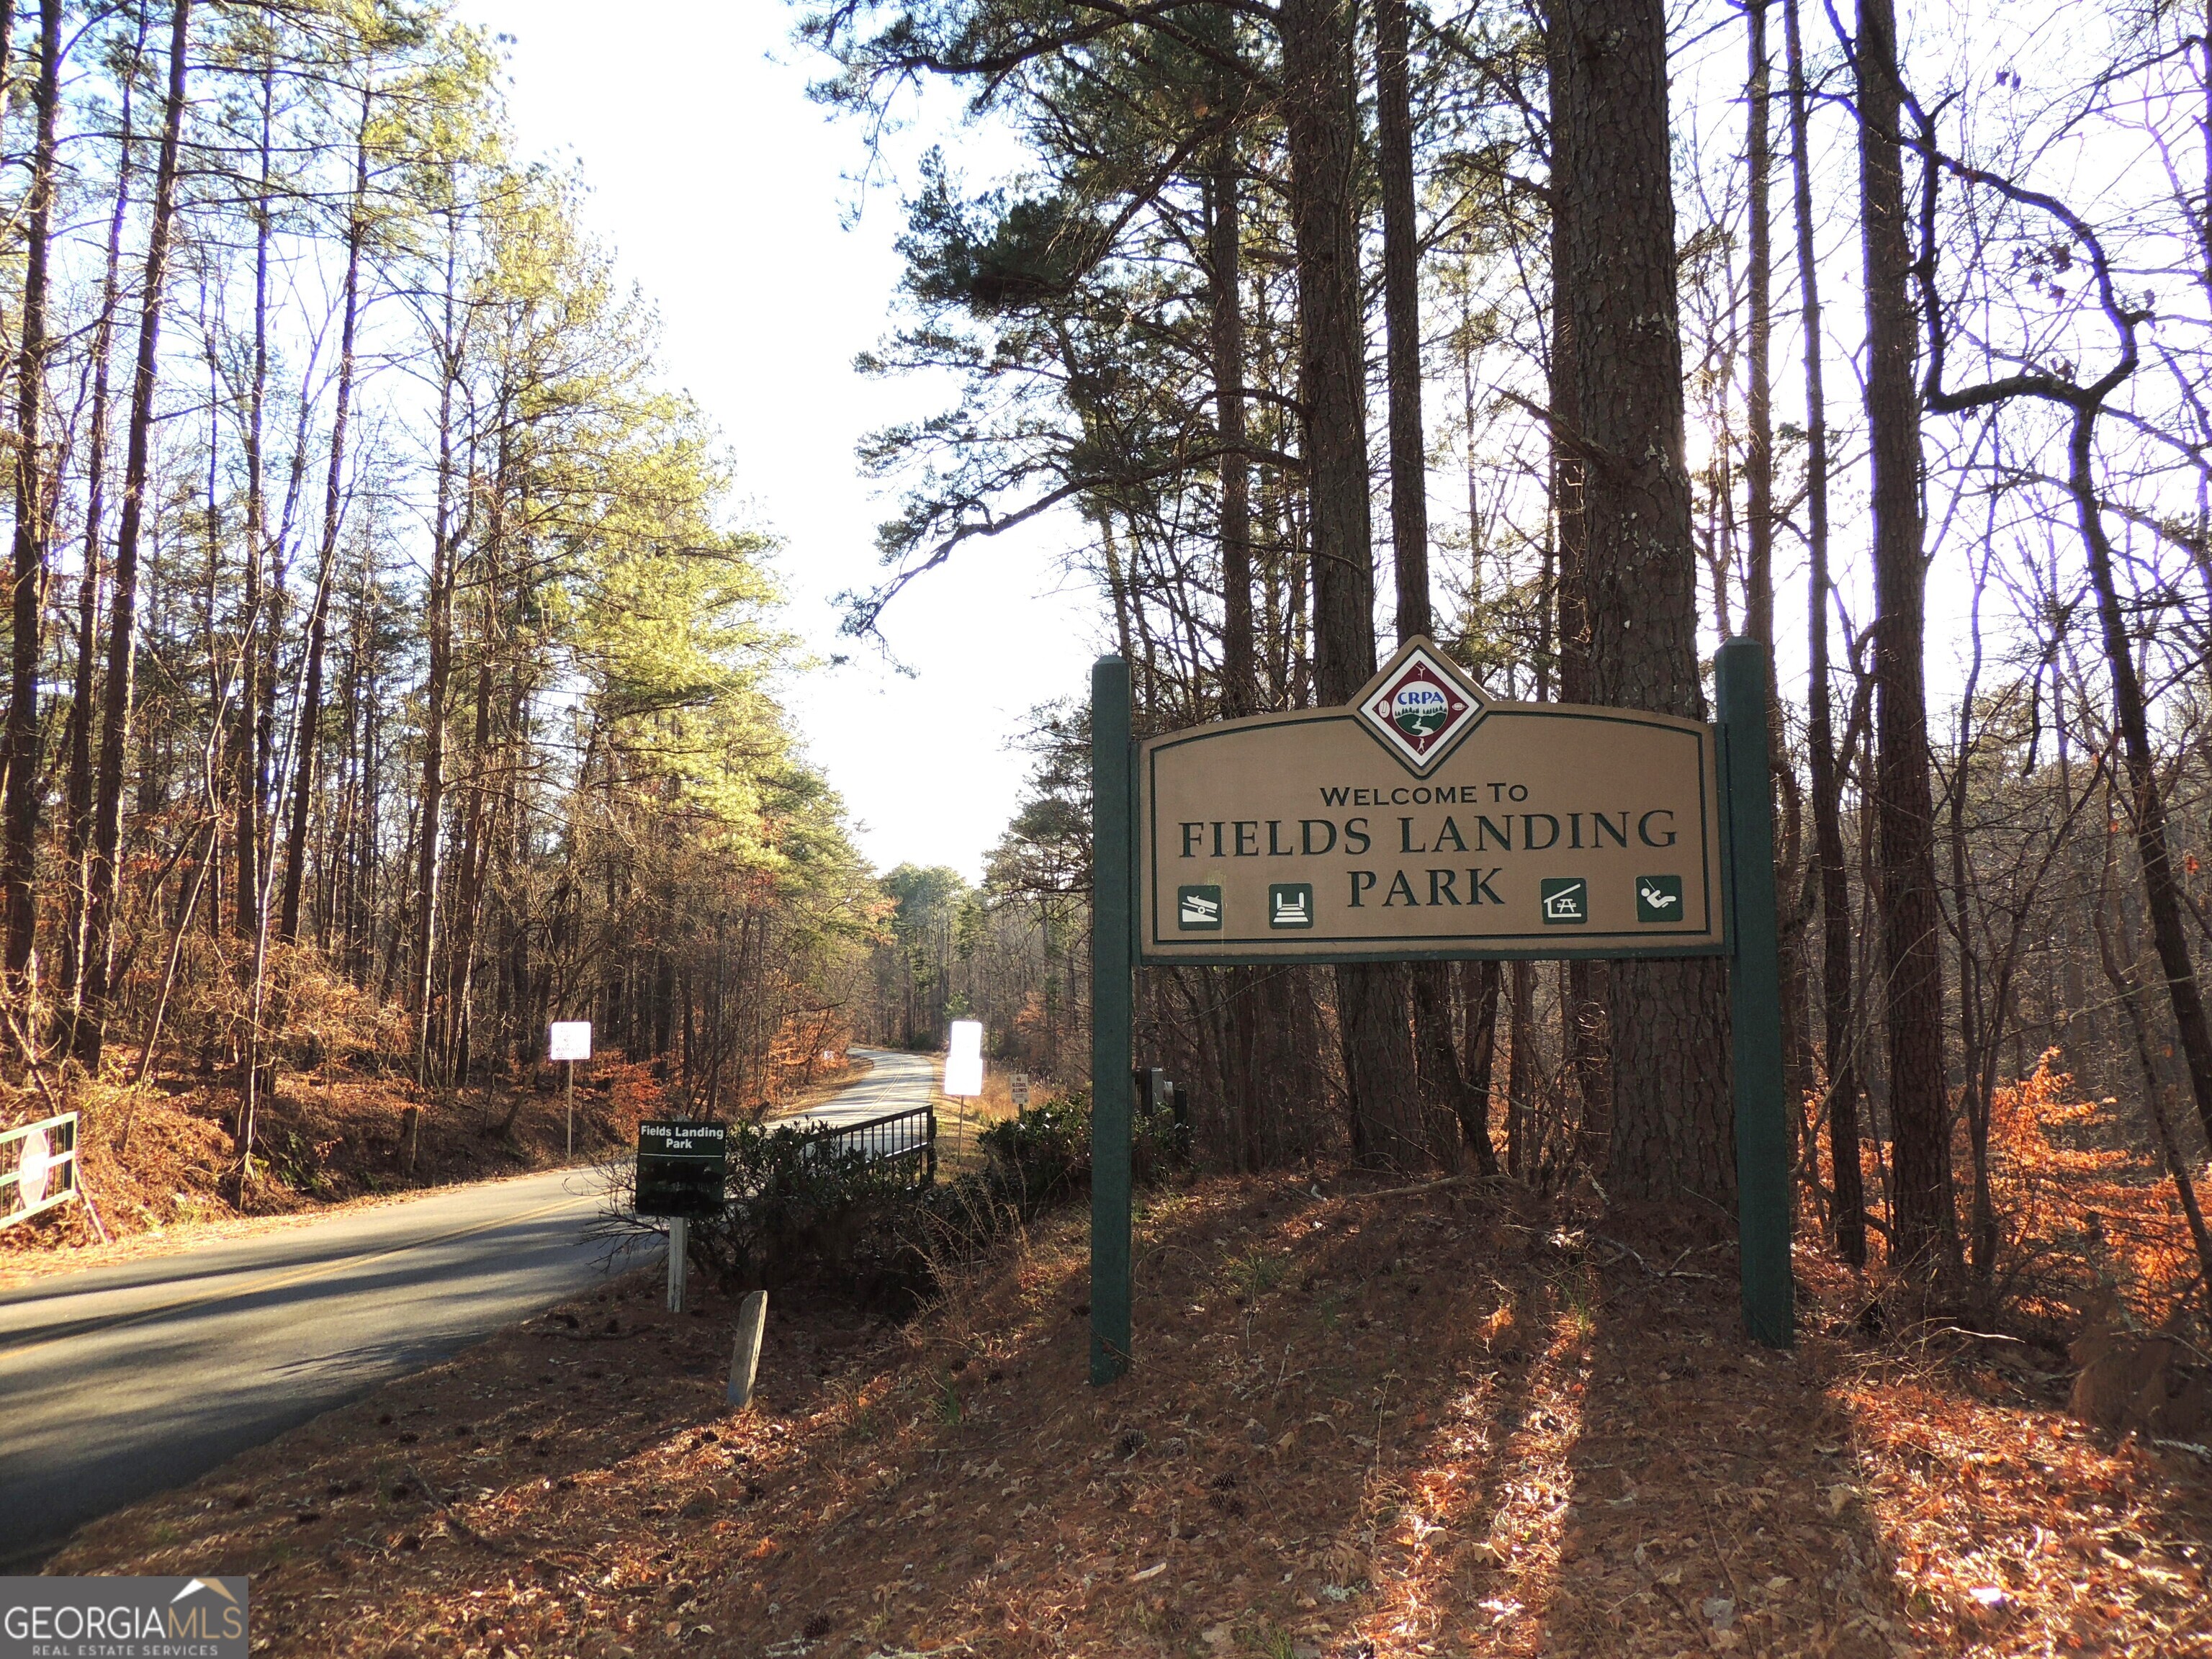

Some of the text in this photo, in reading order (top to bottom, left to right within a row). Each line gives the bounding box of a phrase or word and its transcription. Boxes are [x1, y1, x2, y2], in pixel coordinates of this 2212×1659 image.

[1398, 691, 1444, 705] CRPA
[1320, 783, 1528, 806] WELCOME TO
[1178, 809, 1677, 858] FIELDS LANDING
[1346, 868, 1505, 907] PARK
[641, 1125, 724, 1140] Fields Landing
[666, 1138, 693, 1148] Park
